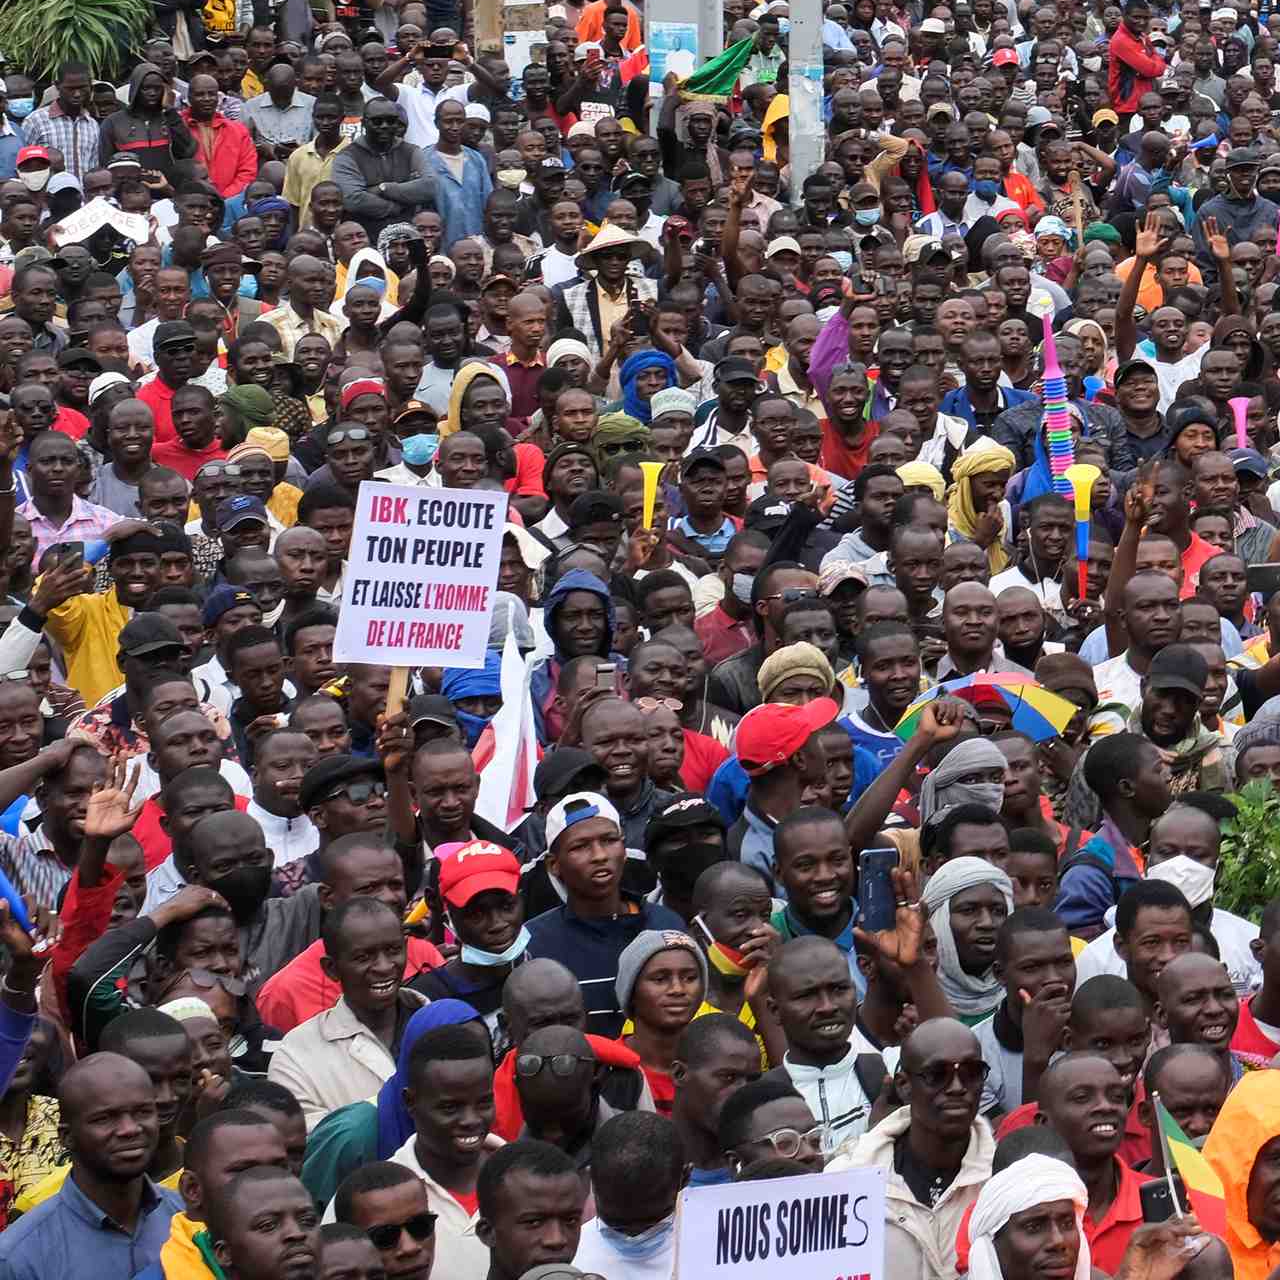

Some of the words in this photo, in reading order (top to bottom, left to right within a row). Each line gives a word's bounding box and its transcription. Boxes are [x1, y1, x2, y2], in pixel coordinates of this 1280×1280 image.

[369, 495, 412, 527] IBK,
[416, 498, 495, 530] ECOUTE
[366, 535, 408, 563] TON
[411, 538, 485, 568] PEUPLE
[351, 579, 370, 606] ET
[371, 580, 423, 608] LAISSE
[423, 583, 489, 612] L'HOMME
[366, 620, 386, 647] DE
[387, 621, 405, 647] LA
[407, 622, 464, 650] FRANCE
[716, 1202, 771, 1265] NOUS
[775, 1193, 869, 1258] SOMMES
